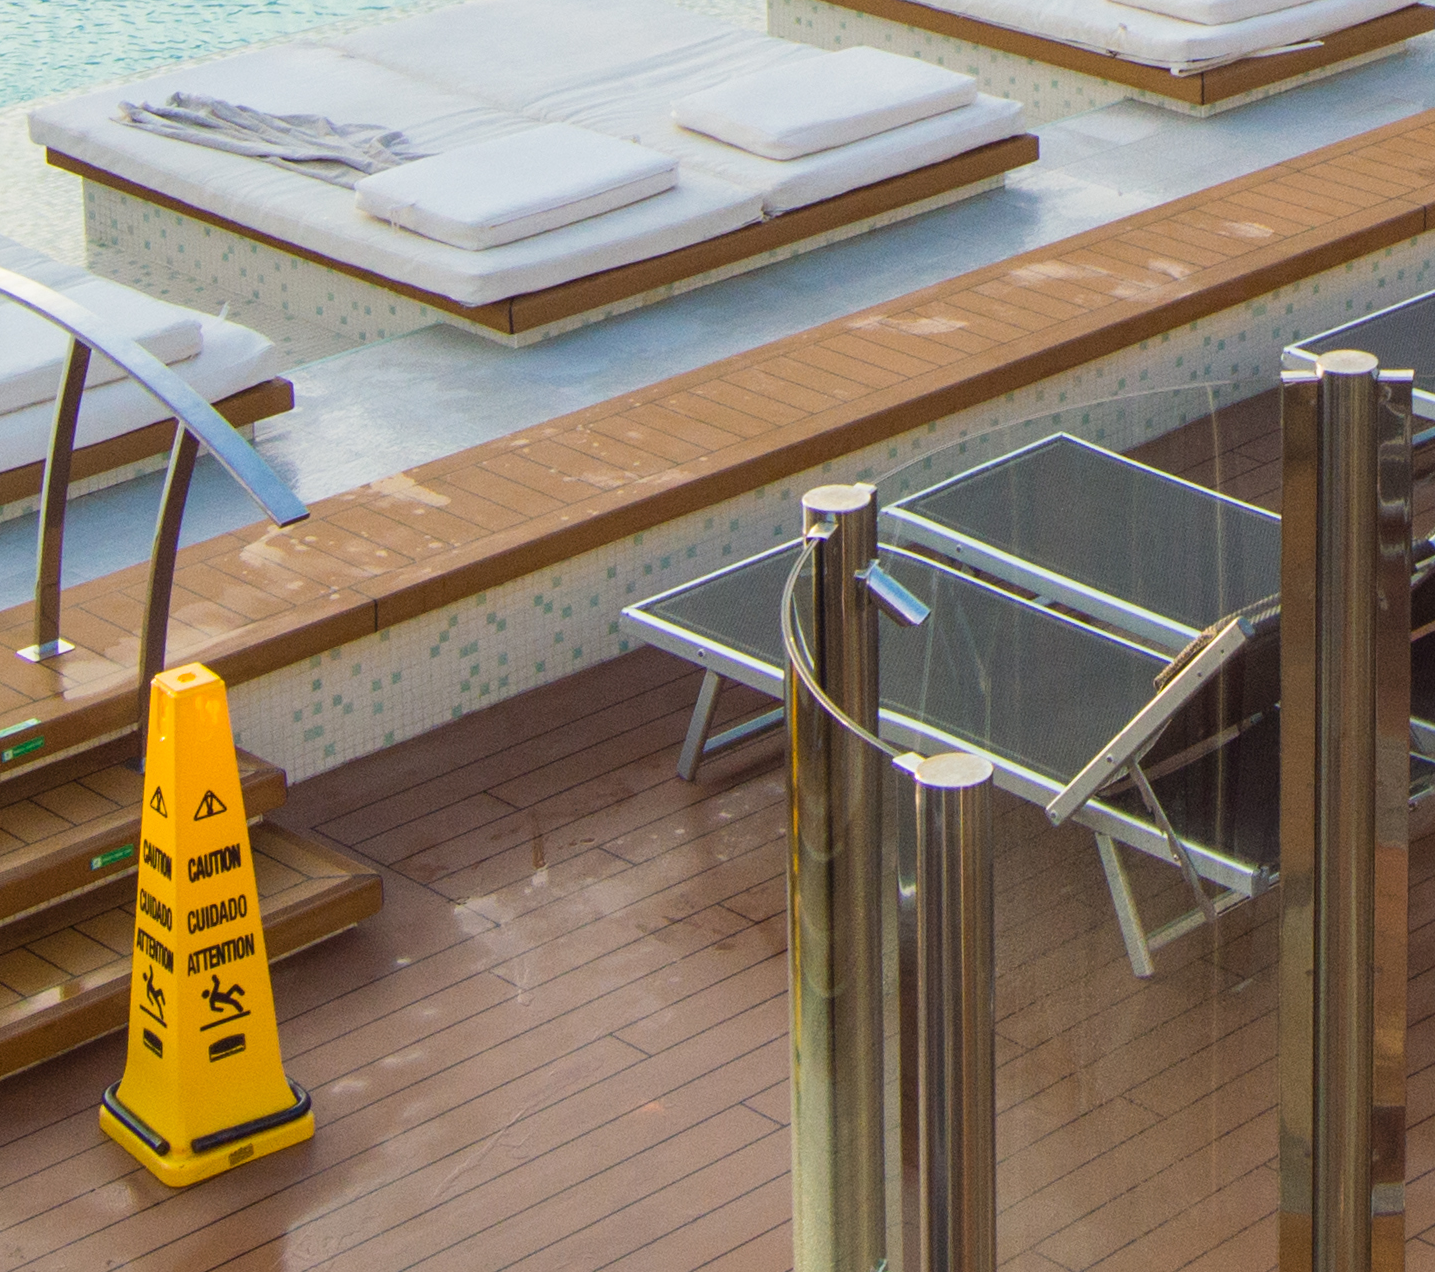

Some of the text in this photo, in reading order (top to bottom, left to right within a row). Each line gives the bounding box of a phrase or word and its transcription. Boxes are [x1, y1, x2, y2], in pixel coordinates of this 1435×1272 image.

[143, 839, 172, 881] CAUTION
[188, 843, 241, 883] CAUTION
[140, 888, 172, 932] CUIDADO
[187, 894, 247, 935] CUIDADO
[136, 927, 174, 974] ATTENTION
[187, 933, 255, 977] ATTENTION
